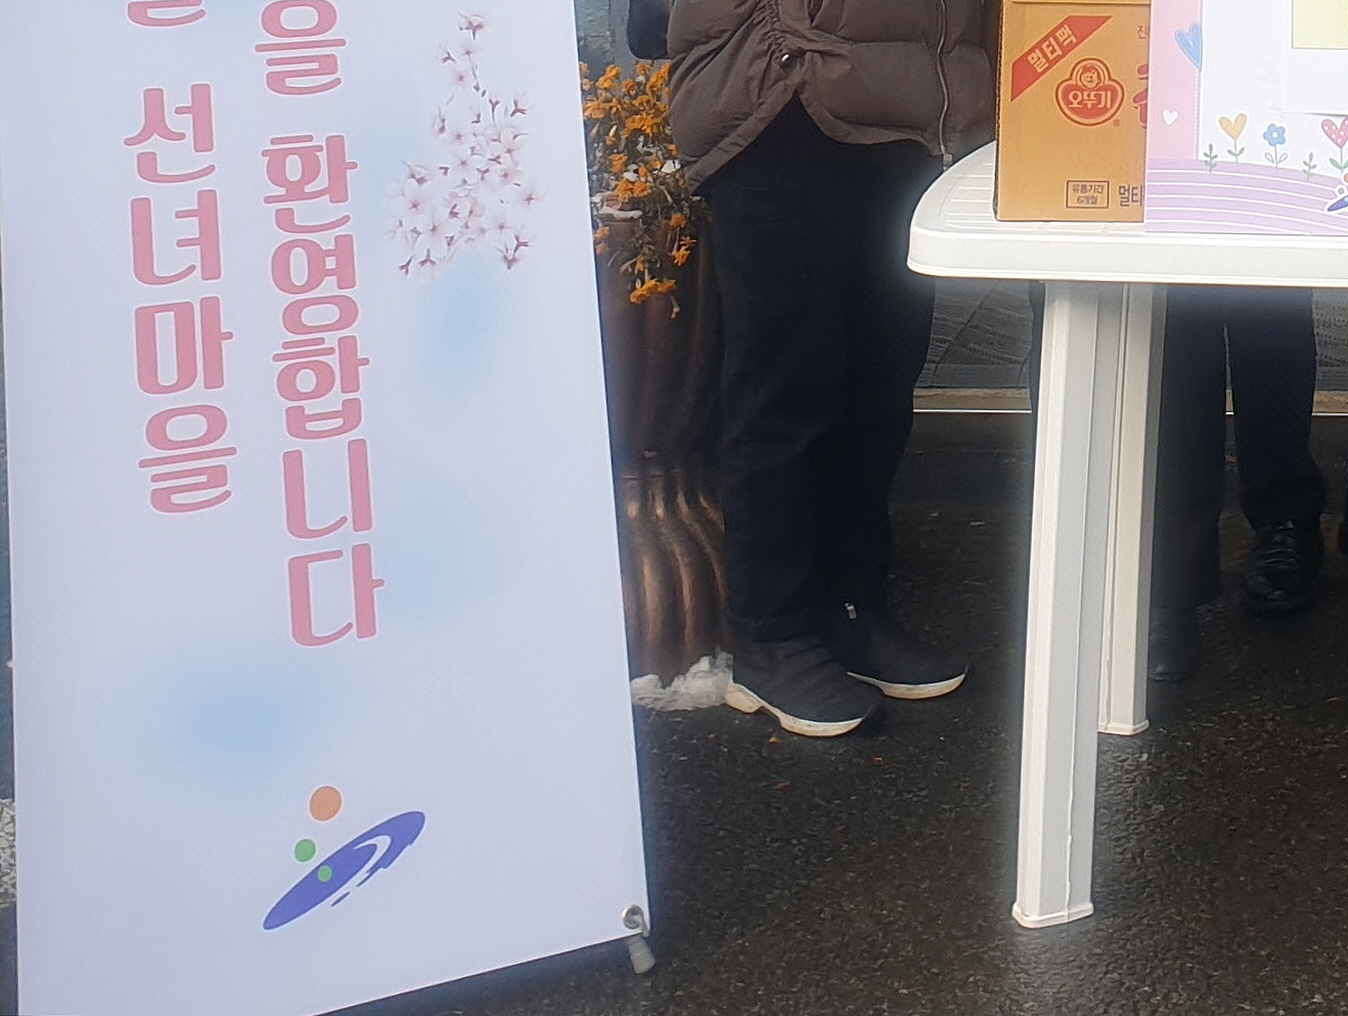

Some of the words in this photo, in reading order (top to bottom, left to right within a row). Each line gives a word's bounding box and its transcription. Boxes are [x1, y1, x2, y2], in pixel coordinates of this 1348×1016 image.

[1068, 90, 1112, 109] 오뚜기
[1118, 184, 1146, 208] 멀티
[123, 82, 237, 515] 선녀마을
[260, 134, 385, 647] 환영합니다
